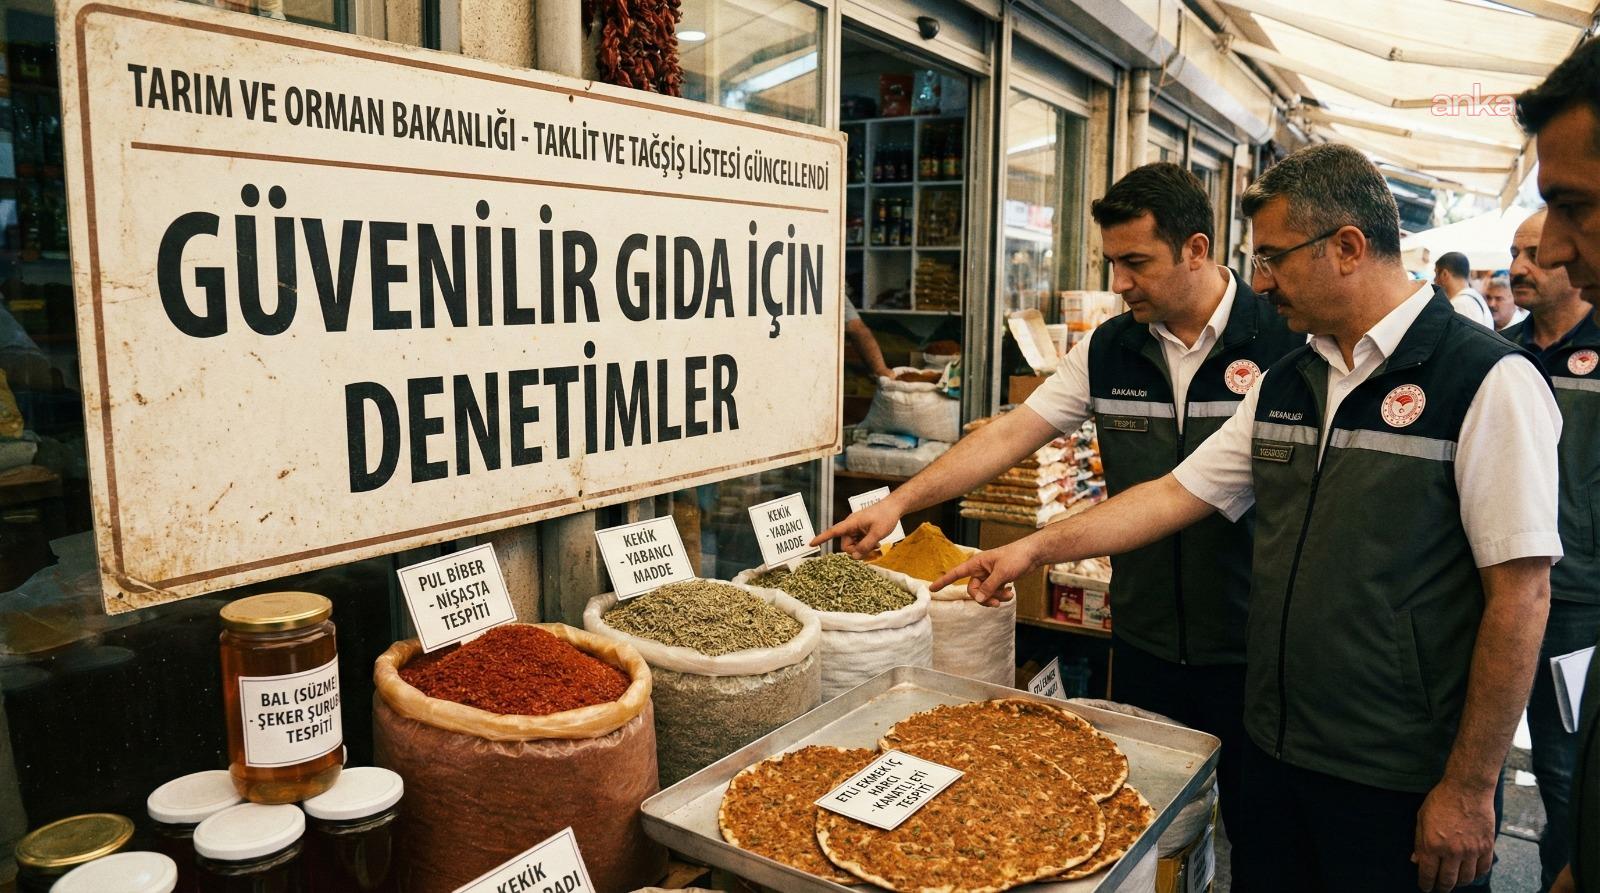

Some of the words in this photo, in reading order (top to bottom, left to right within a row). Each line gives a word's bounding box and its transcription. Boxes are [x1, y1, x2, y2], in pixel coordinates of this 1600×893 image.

[127, 63, 233, 118] TARIM
[239, 79, 278, 124] VE
[284, 86, 385, 136] ORMAN
[392, 101, 516, 152] BAKANLIĞI
[533, 121, 599, 161] TAKLİT
[603, 132, 625, 165] VE
[628, 133, 685, 179] TAĞŞİŞ
[689, 139, 741, 180] LİSTESİ
[744, 150, 829, 191] GÜNCELLENDİ
[157, 183, 600, 338] GÜVENİLİR
[615, 233, 735, 322] GIDA
[748, 220, 824, 339] İÇİN
[345, 341, 740, 493] DENETİMLER
[767, 505, 792, 522] KEKİK
[623, 528, 657, 548] KEKİK
[775, 536, 805, 555] MADDE
[626, 544, 674, 566] YABANCI
[418, 571, 446, 592] PUL
[446, 559, 486, 584] BİBER
[633, 562, 674, 584] MADDE
[436, 580, 490, 610] NİŞASTA
[441, 599, 491, 631] TESPİTİ
[261, 691, 290, 707] BAL
[258, 708, 304, 731] ŞEKER
[286, 714, 333, 744] TESPİTİ
[835, 785, 861, 803] ETLİ
[857, 766, 891, 789] EKMEK
[881, 758, 903, 768] İÇ
[867, 775, 901, 797] HARCI
[908, 769, 929, 785] ETİ
[896, 779, 934, 809] TESPİTİ
